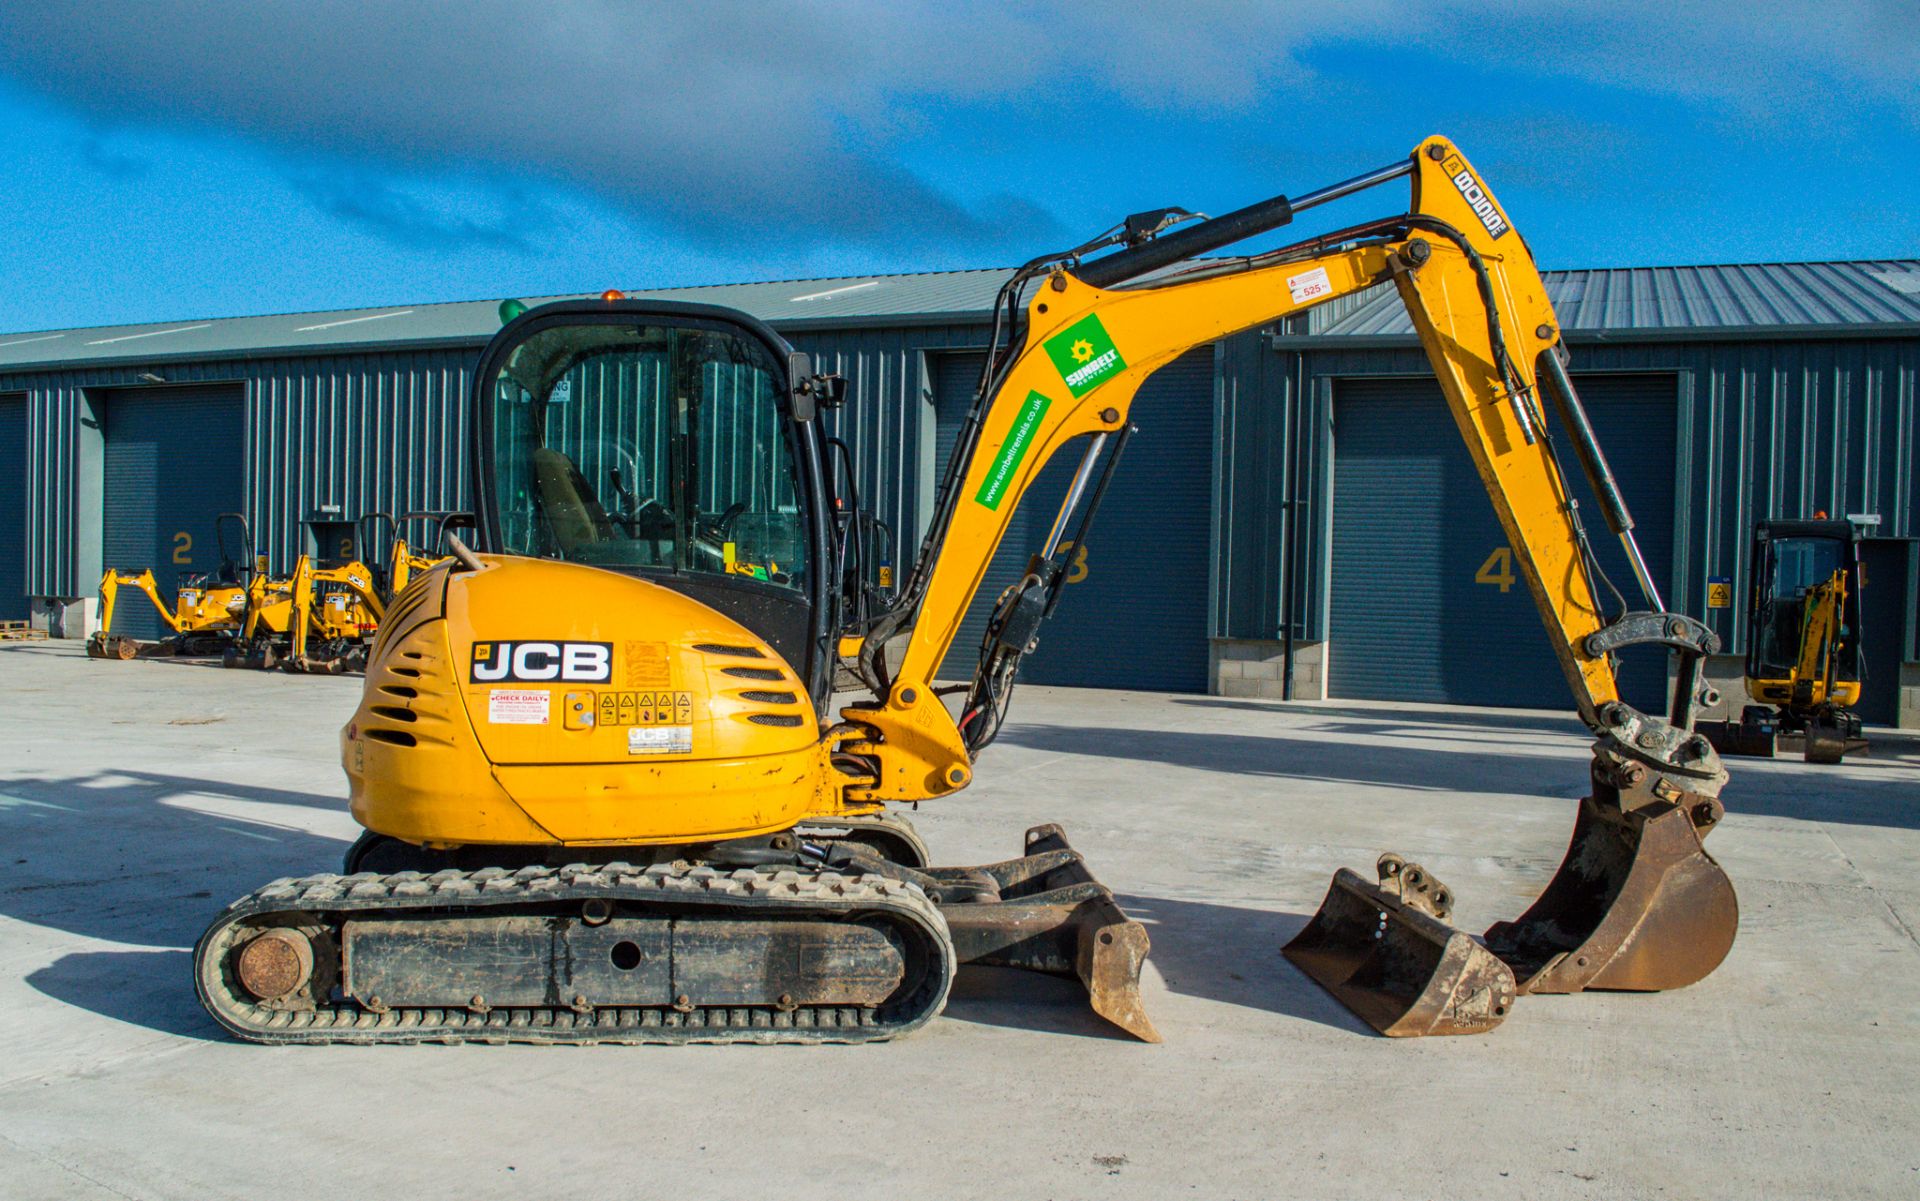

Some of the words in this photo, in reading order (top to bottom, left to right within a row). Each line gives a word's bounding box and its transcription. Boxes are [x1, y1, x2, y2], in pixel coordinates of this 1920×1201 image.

[1453, 171, 1503, 230] 8055
[1303, 284, 1322, 297] 525
[1065, 349, 1117, 387] SUNBELT
[1077, 363, 1114, 387] RENTALS
[985, 398, 1043, 503] www.sunbeltrentals.co.uk
[172, 531, 193, 565] 2
[340, 538, 353, 558] 2
[1056, 541, 1089, 584] 3
[347, 574, 366, 588] JCB
[1475, 547, 1516, 593] 4
[325, 596, 345, 604] JCB
[474, 643, 609, 681] JCB
